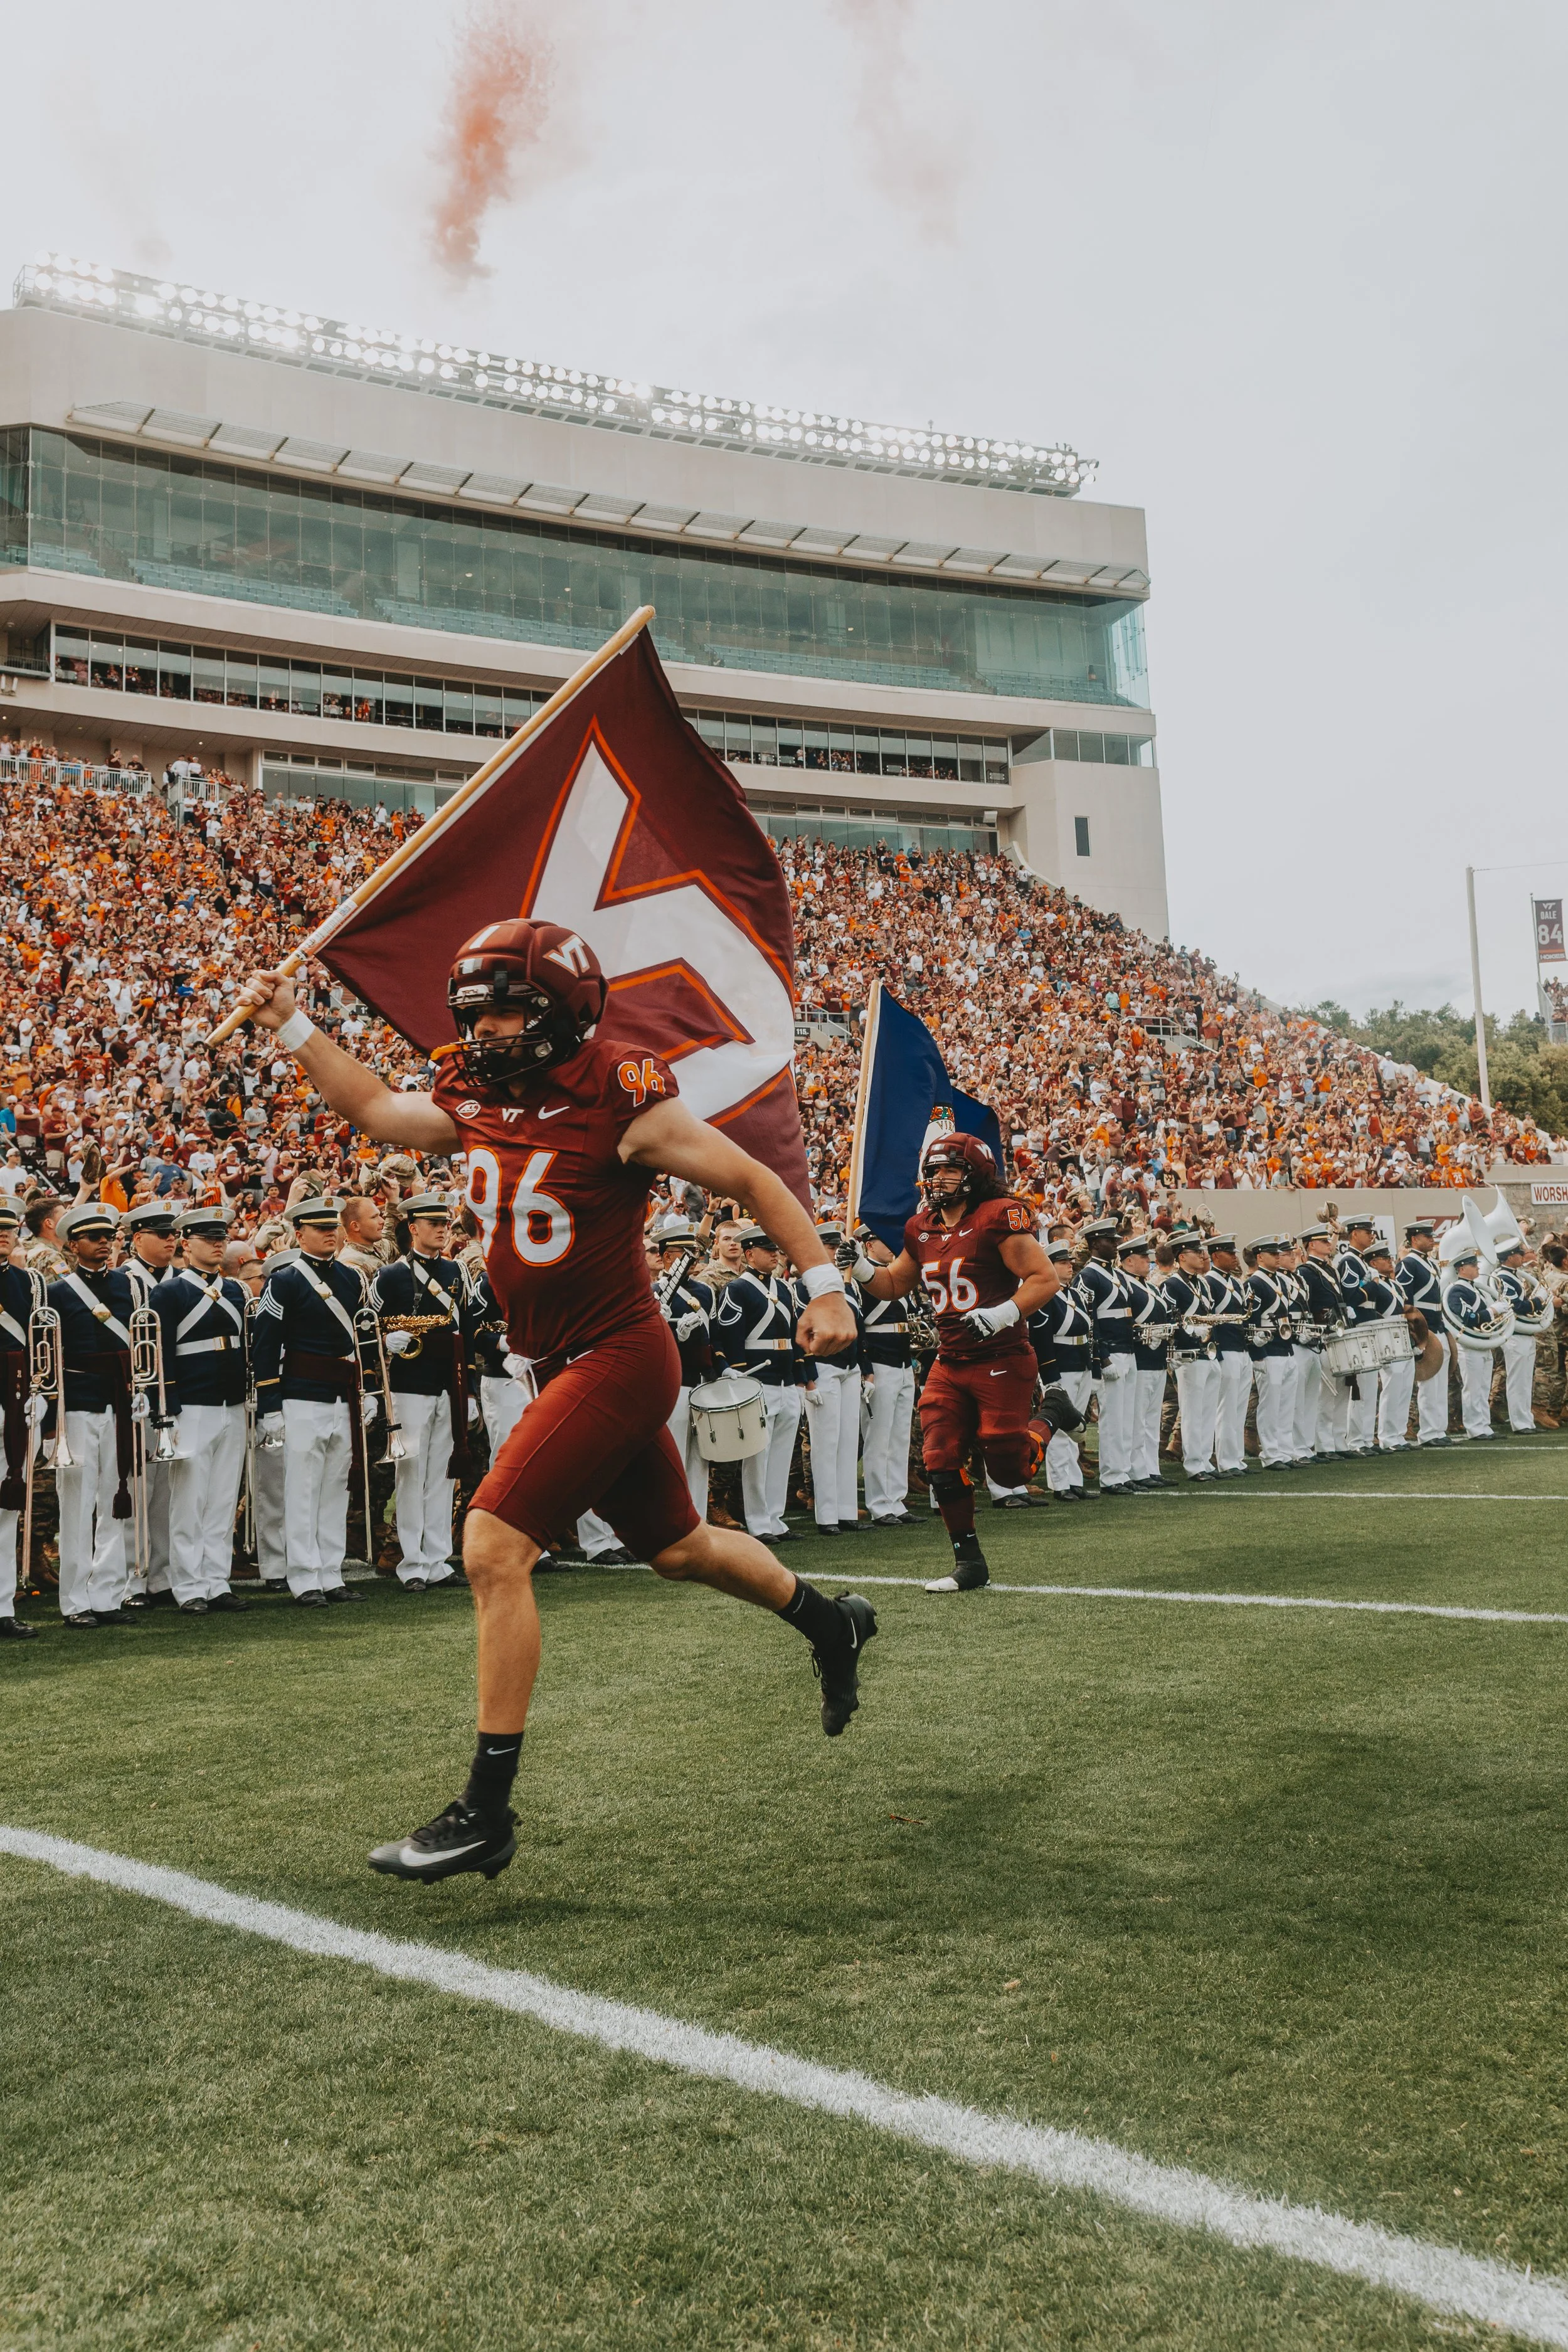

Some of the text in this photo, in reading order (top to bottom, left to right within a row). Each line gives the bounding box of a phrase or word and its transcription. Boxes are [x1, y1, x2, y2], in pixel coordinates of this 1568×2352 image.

[1540, 911, 1557, 919] DALE
[1538, 924, 1563, 945] 84
[544, 935, 590, 978] VT
[617, 1058, 666, 1108] 96
[502, 1108, 525, 1123] VT
[975, 1143, 993, 1160] VT
[1453, 1174, 1463, 1184] 25
[1534, 1186, 1568, 1201] WORSH
[467, 1145, 575, 1267] 96
[1007, 1207, 1030, 1231] 56
[921, 1257, 979, 1315] 56
